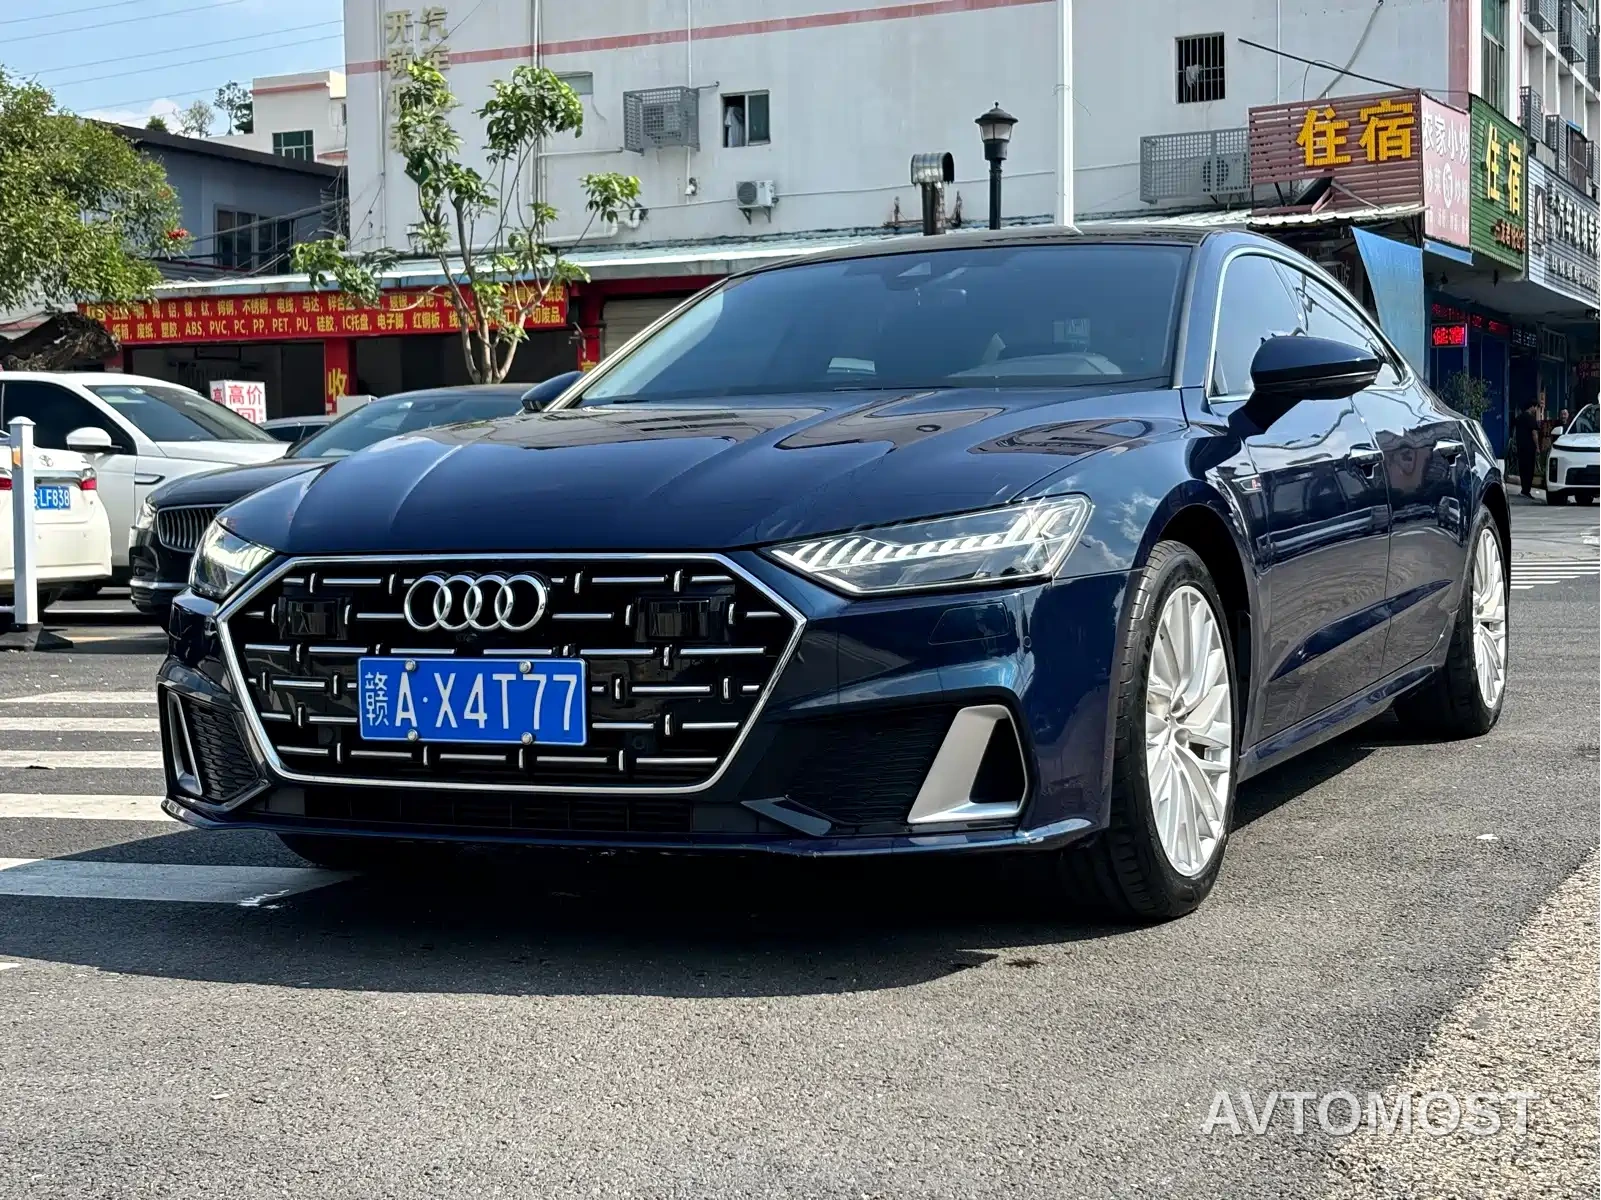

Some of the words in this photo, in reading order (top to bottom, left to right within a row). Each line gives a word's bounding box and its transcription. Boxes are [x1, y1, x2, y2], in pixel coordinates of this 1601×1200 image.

[1296, 100, 1415, 167] 住宿
[1422, 109, 1469, 166] 农家小炒
[1485, 120, 1521, 216] 住宿
[228, 384, 262, 405] 高价
[328, 367, 348, 400] 收
[364, 671, 578, 731] 赣A·X4T77
